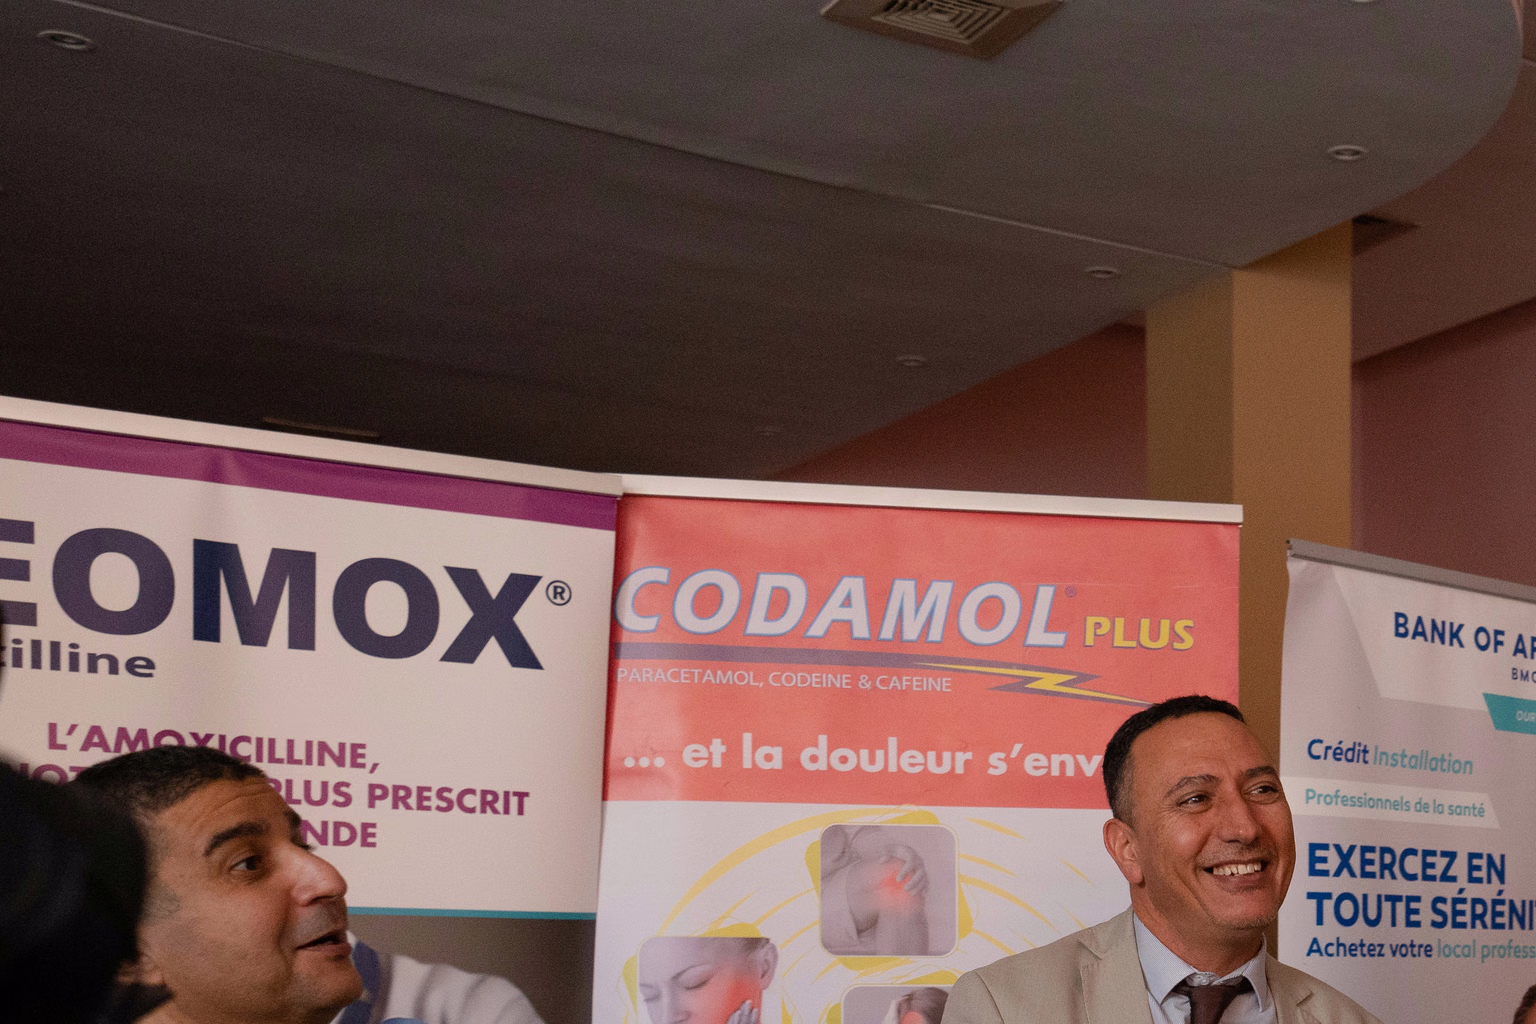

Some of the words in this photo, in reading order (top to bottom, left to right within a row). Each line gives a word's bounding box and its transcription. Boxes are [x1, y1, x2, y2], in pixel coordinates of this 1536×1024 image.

[614, 566, 1067, 648] CODAMOL
[1083, 615, 1195, 651] PLUS
[1394, 611, 1464, 649] BANK
[1474, 625, 1506, 653] OF
[0, 638, 156, 678] illine
[616, 667, 763, 688] PARACETAMOL,
[768, 671, 852, 689] CODEINE
[858, 674, 873, 690] &
[876, 675, 952, 692] CAFEINE
[682, 738, 727, 768] et
[742, 732, 783, 770] la
[800, 735, 973, 776] douleur
[1307, 738, 1369, 766] Crédit
[1373, 745, 1474, 776] Installation
[367, 785, 530, 816] PRESCRIT
[1305, 788, 1411, 813] Professionnels
[1414, 794, 1430, 814] de
[1433, 796, 1446, 815] la
[1448, 801, 1486, 819] santé
[1307, 842, 1458, 884] EXERCEZ
[1467, 852, 1507, 886] EN
[1306, 891, 1422, 929] TOUTE
[1306, 937, 1386, 959] Achetez
[1389, 941, 1433, 960] votre
[1437, 938, 1477, 960] local
